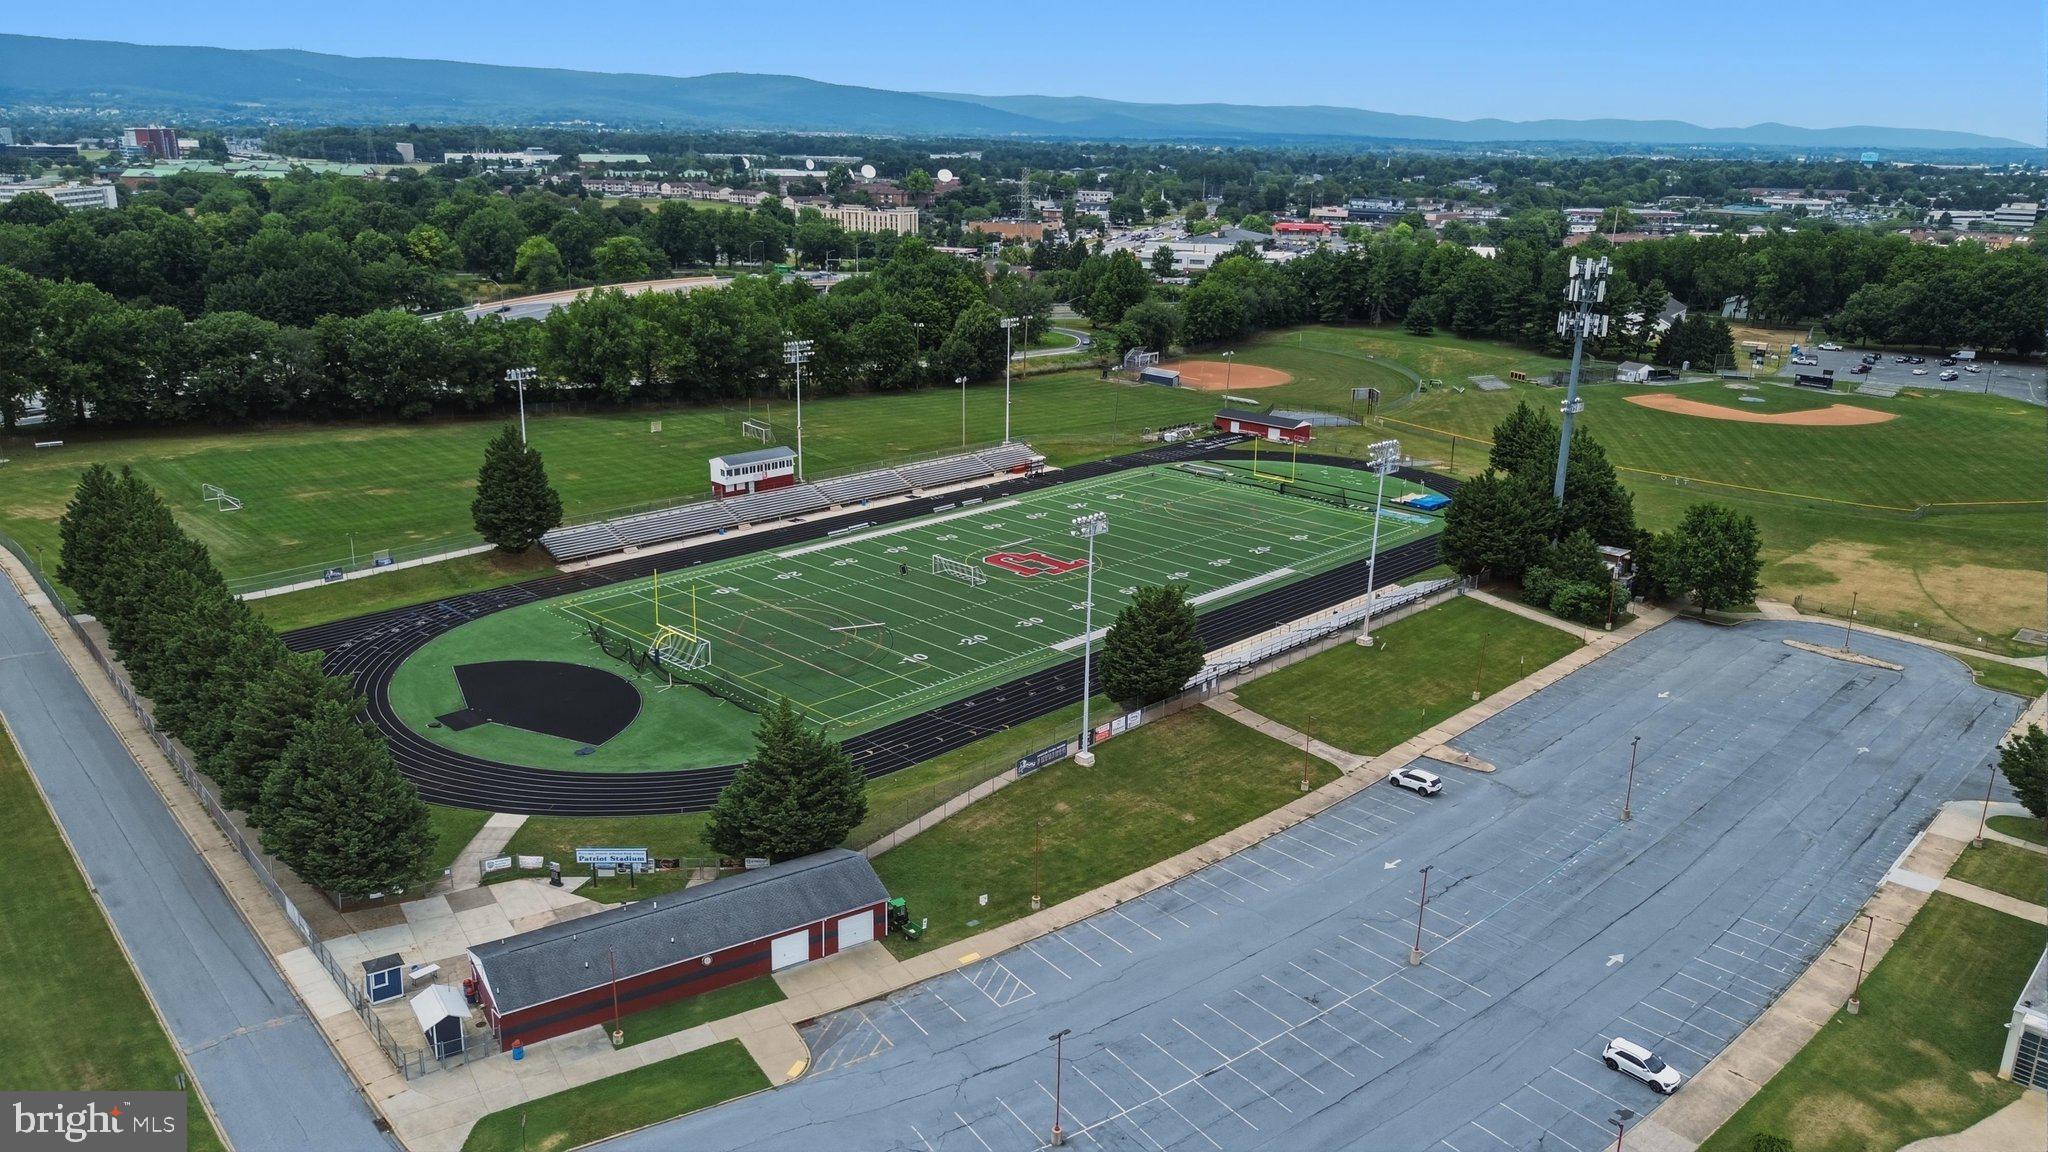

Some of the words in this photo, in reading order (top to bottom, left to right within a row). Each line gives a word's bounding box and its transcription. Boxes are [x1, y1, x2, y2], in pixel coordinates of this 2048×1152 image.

[1017, 617, 1044, 627] 30
[960, 634, 989, 646] 20
[902, 653, 929, 664] 10
